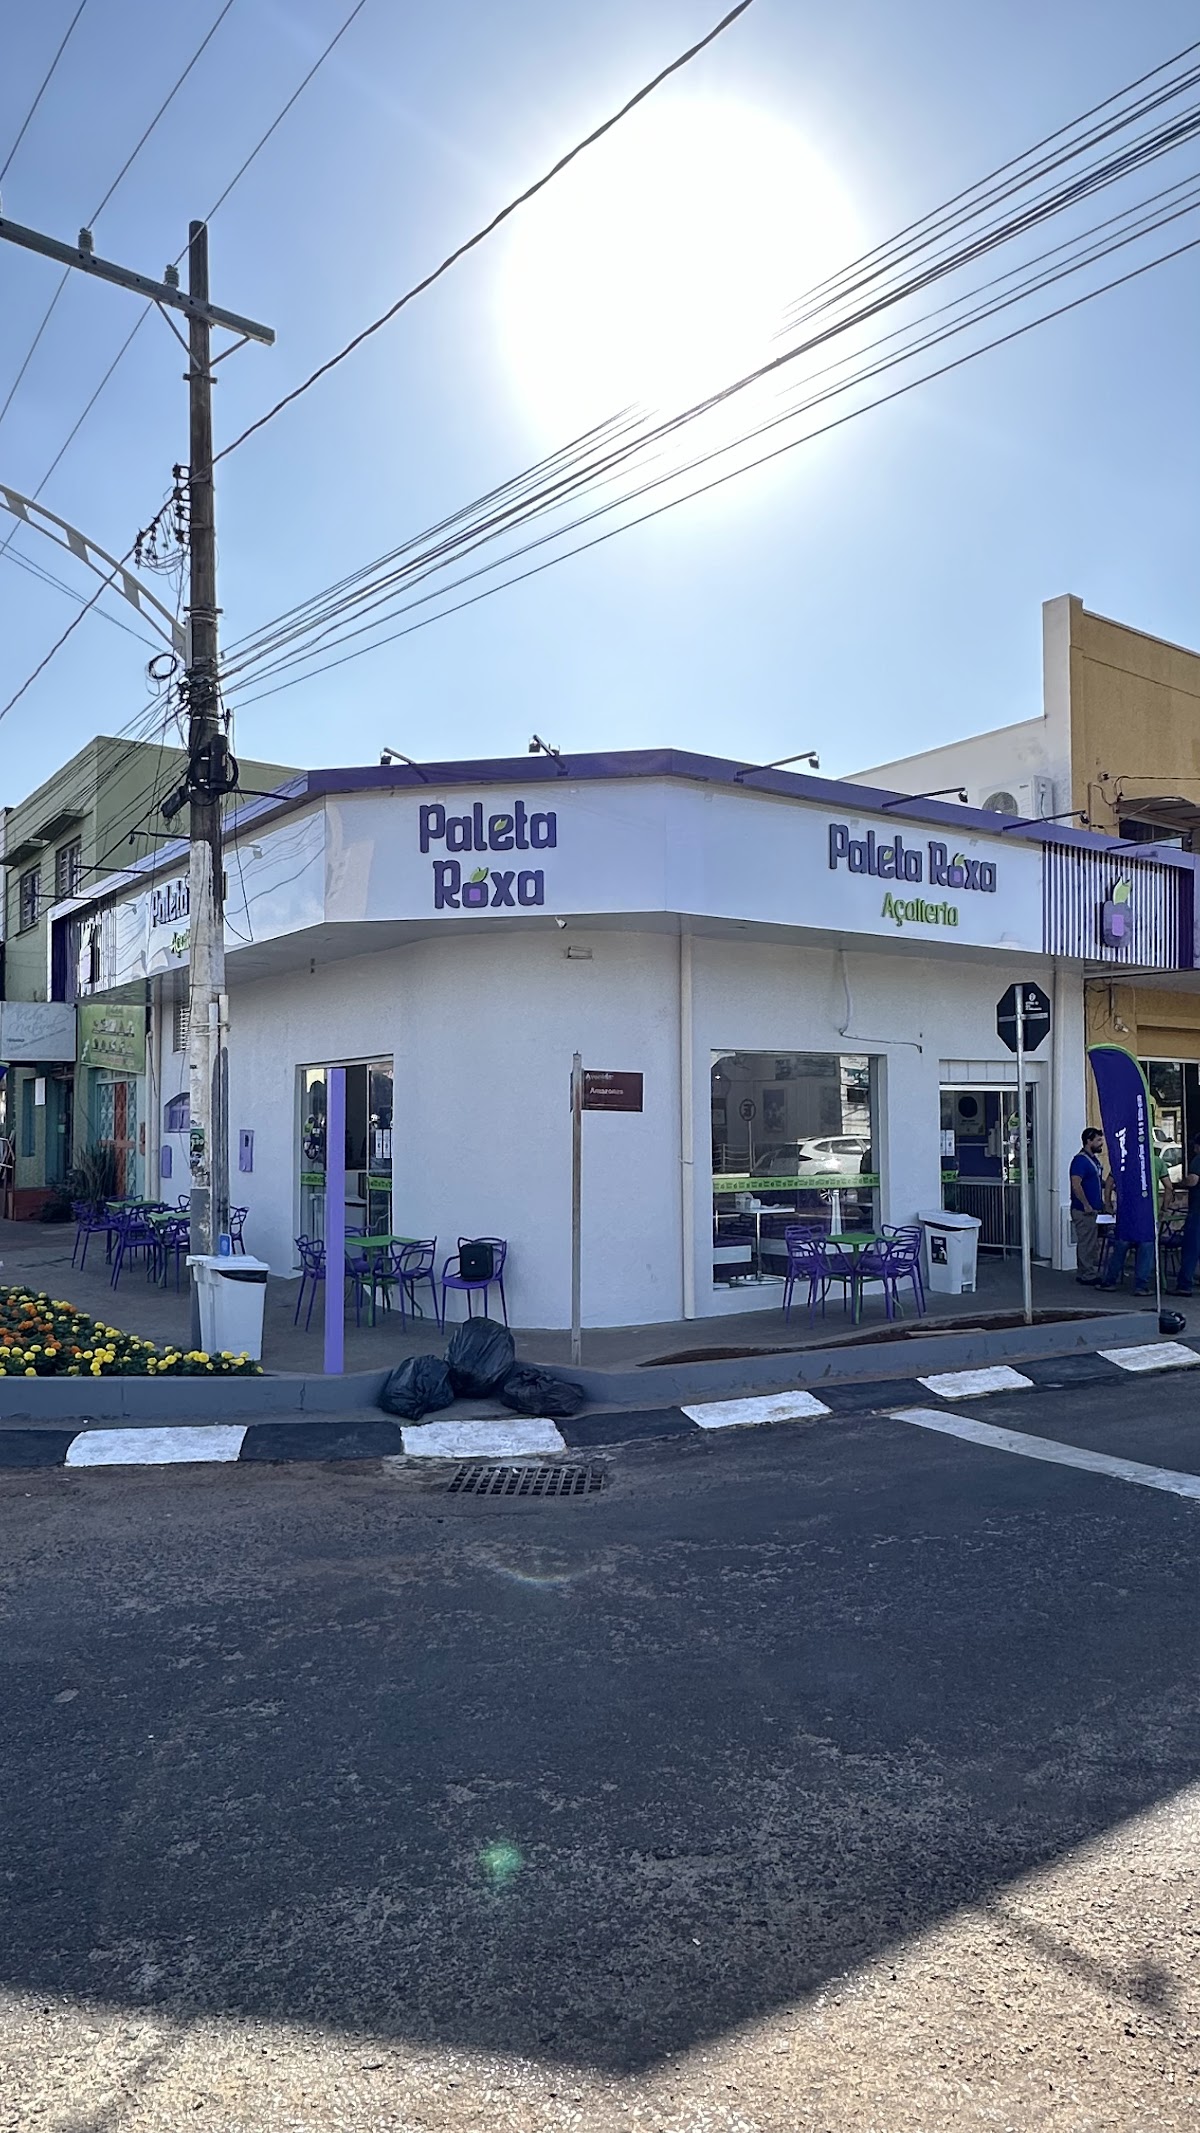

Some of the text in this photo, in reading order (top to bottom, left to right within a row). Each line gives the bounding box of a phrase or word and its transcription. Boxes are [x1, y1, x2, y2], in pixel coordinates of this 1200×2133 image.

[419, 800, 557, 854] Paleta
[432, 860, 545, 909] Roxa
[828, 823, 997, 893] Paleta Roxa
